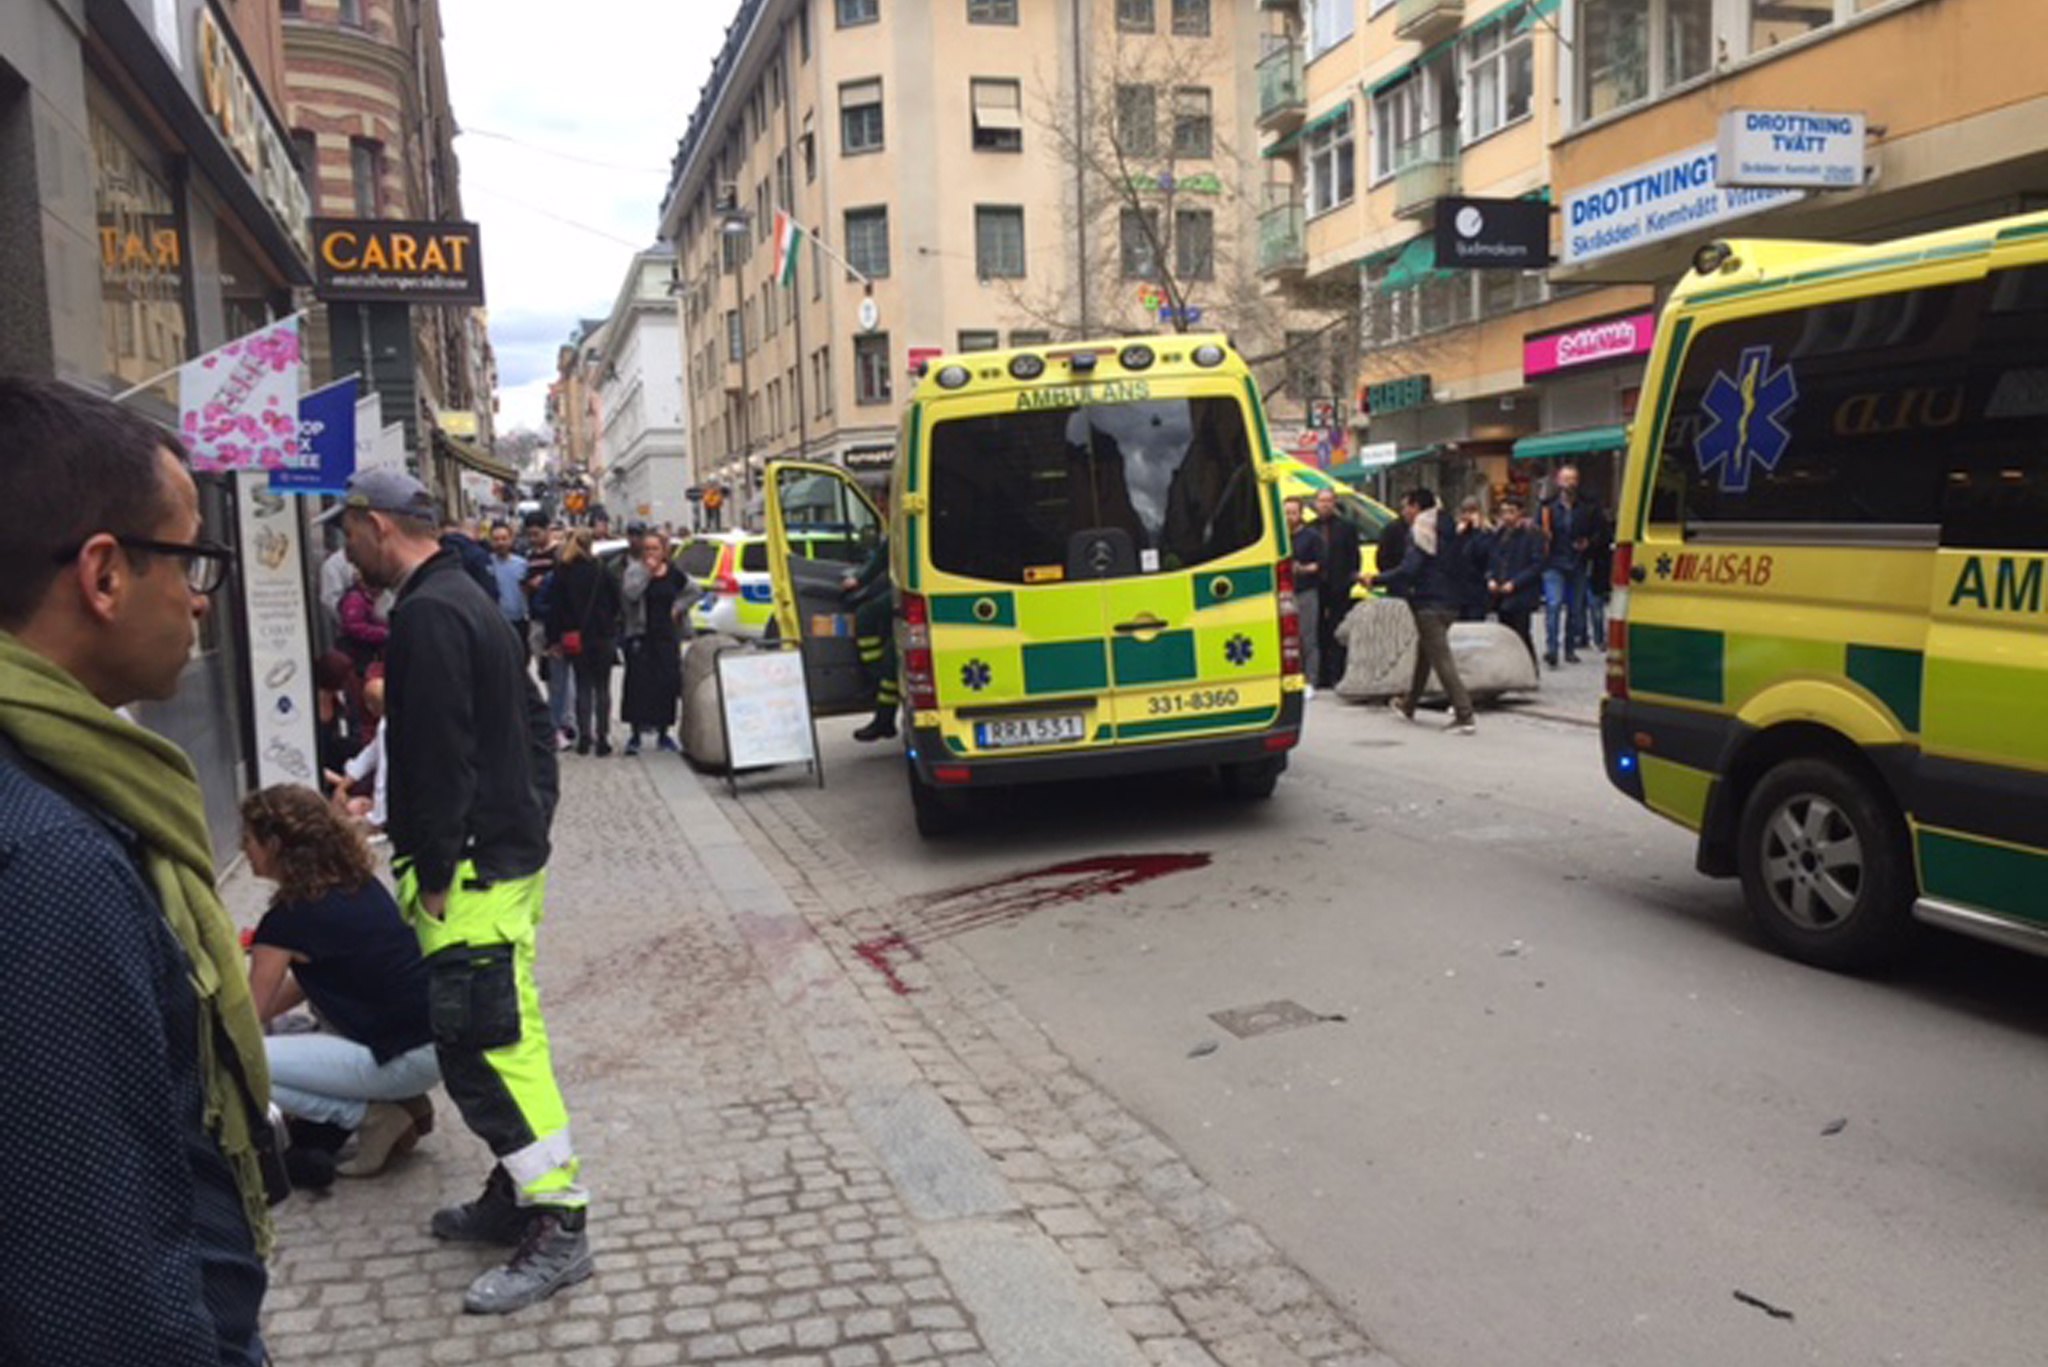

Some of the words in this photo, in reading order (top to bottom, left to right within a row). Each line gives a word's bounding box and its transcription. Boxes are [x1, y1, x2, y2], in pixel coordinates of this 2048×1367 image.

[1746, 114, 1852, 134] DROTTNING
[1572, 153, 1718, 226] DROTTNINGT
[321, 231, 469, 272] CARAT
[1017, 379, 1149, 411] AMBULANS
[1947, 556, 2048, 613] AM
[1148, 689, 1239, 714] 331-8360
[991, 720, 1031, 740] RRA
